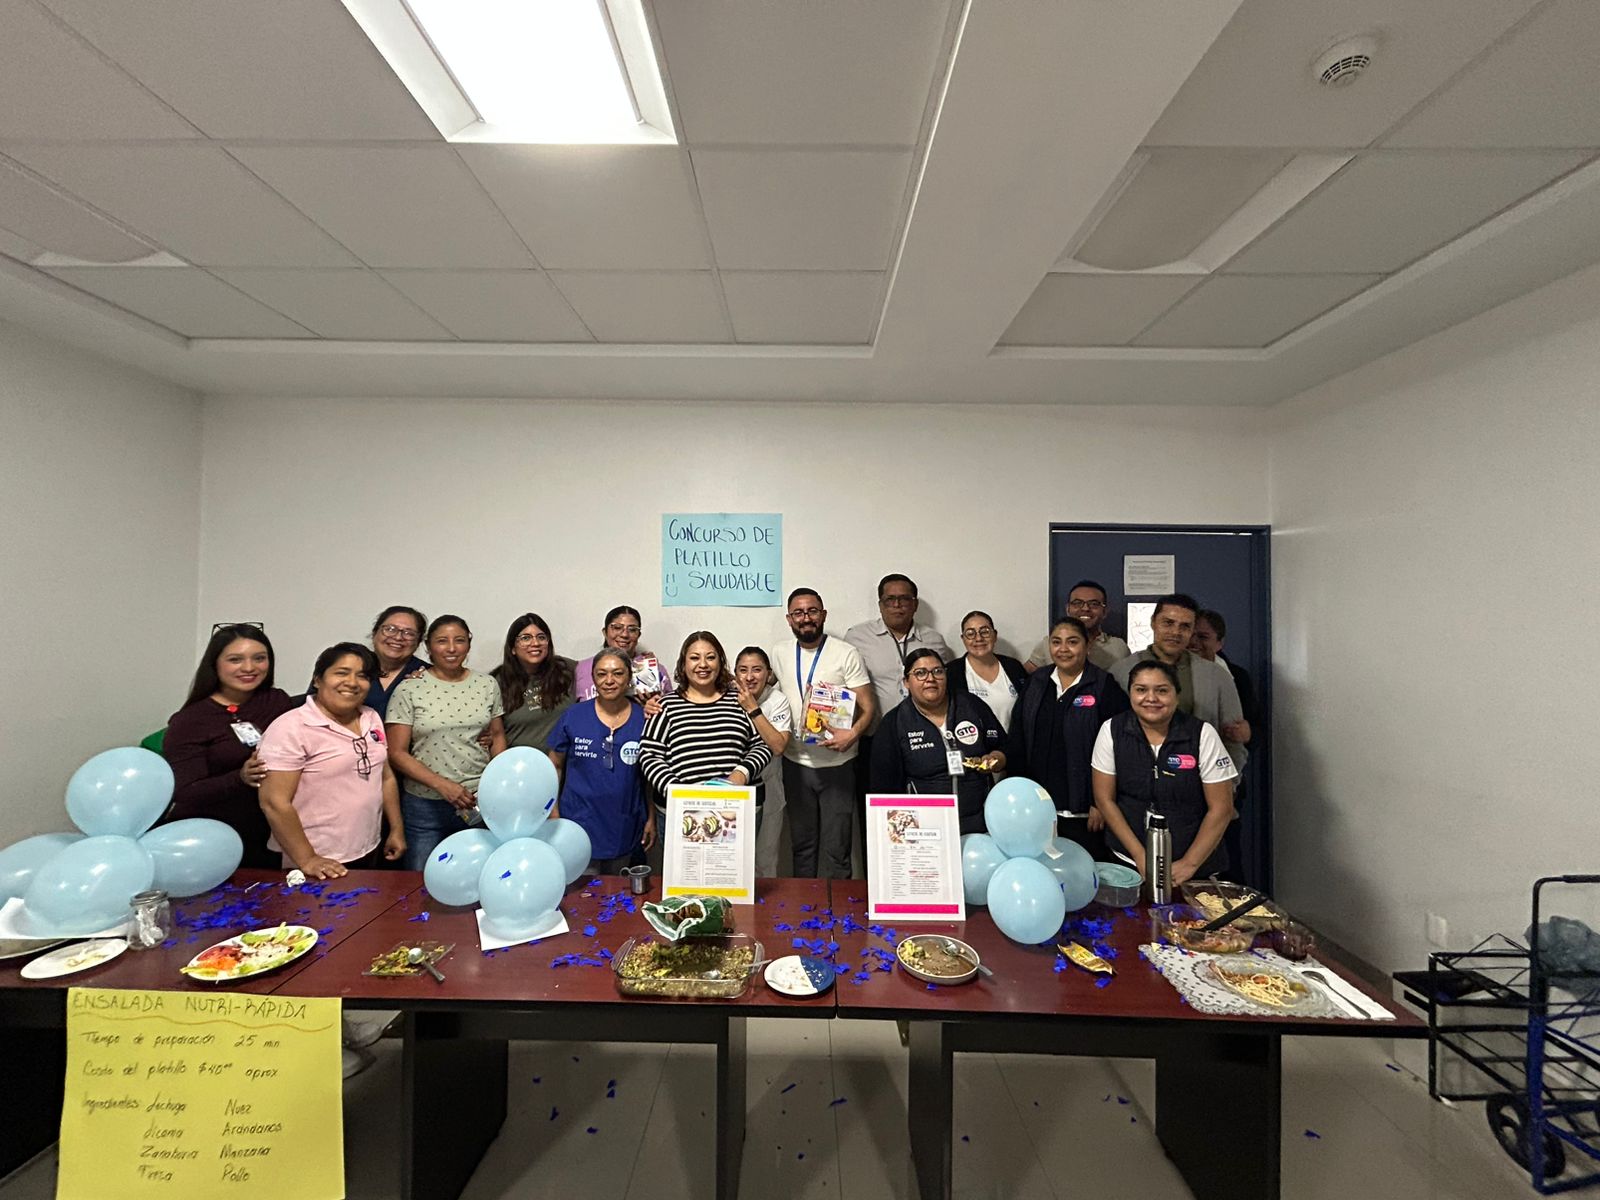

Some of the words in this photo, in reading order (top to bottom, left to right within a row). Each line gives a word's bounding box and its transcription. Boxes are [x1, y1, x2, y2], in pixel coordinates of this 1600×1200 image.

[669, 519, 746, 543] CONCURSO
[753, 526, 775, 545] DE
[675, 548, 751, 568] PLATILLO
[688, 571, 776, 592] SALUDABLE
[957, 726, 976, 736] GTO
[73, 992, 165, 1012] ENSALADA
[133, 1033, 145, 1046] de
[233, 1034, 259, 1048] 25
[245, 1068, 279, 1082] aprox
[225, 1098, 252, 1116] Nuez
[222, 1162, 250, 1182] Pollo
